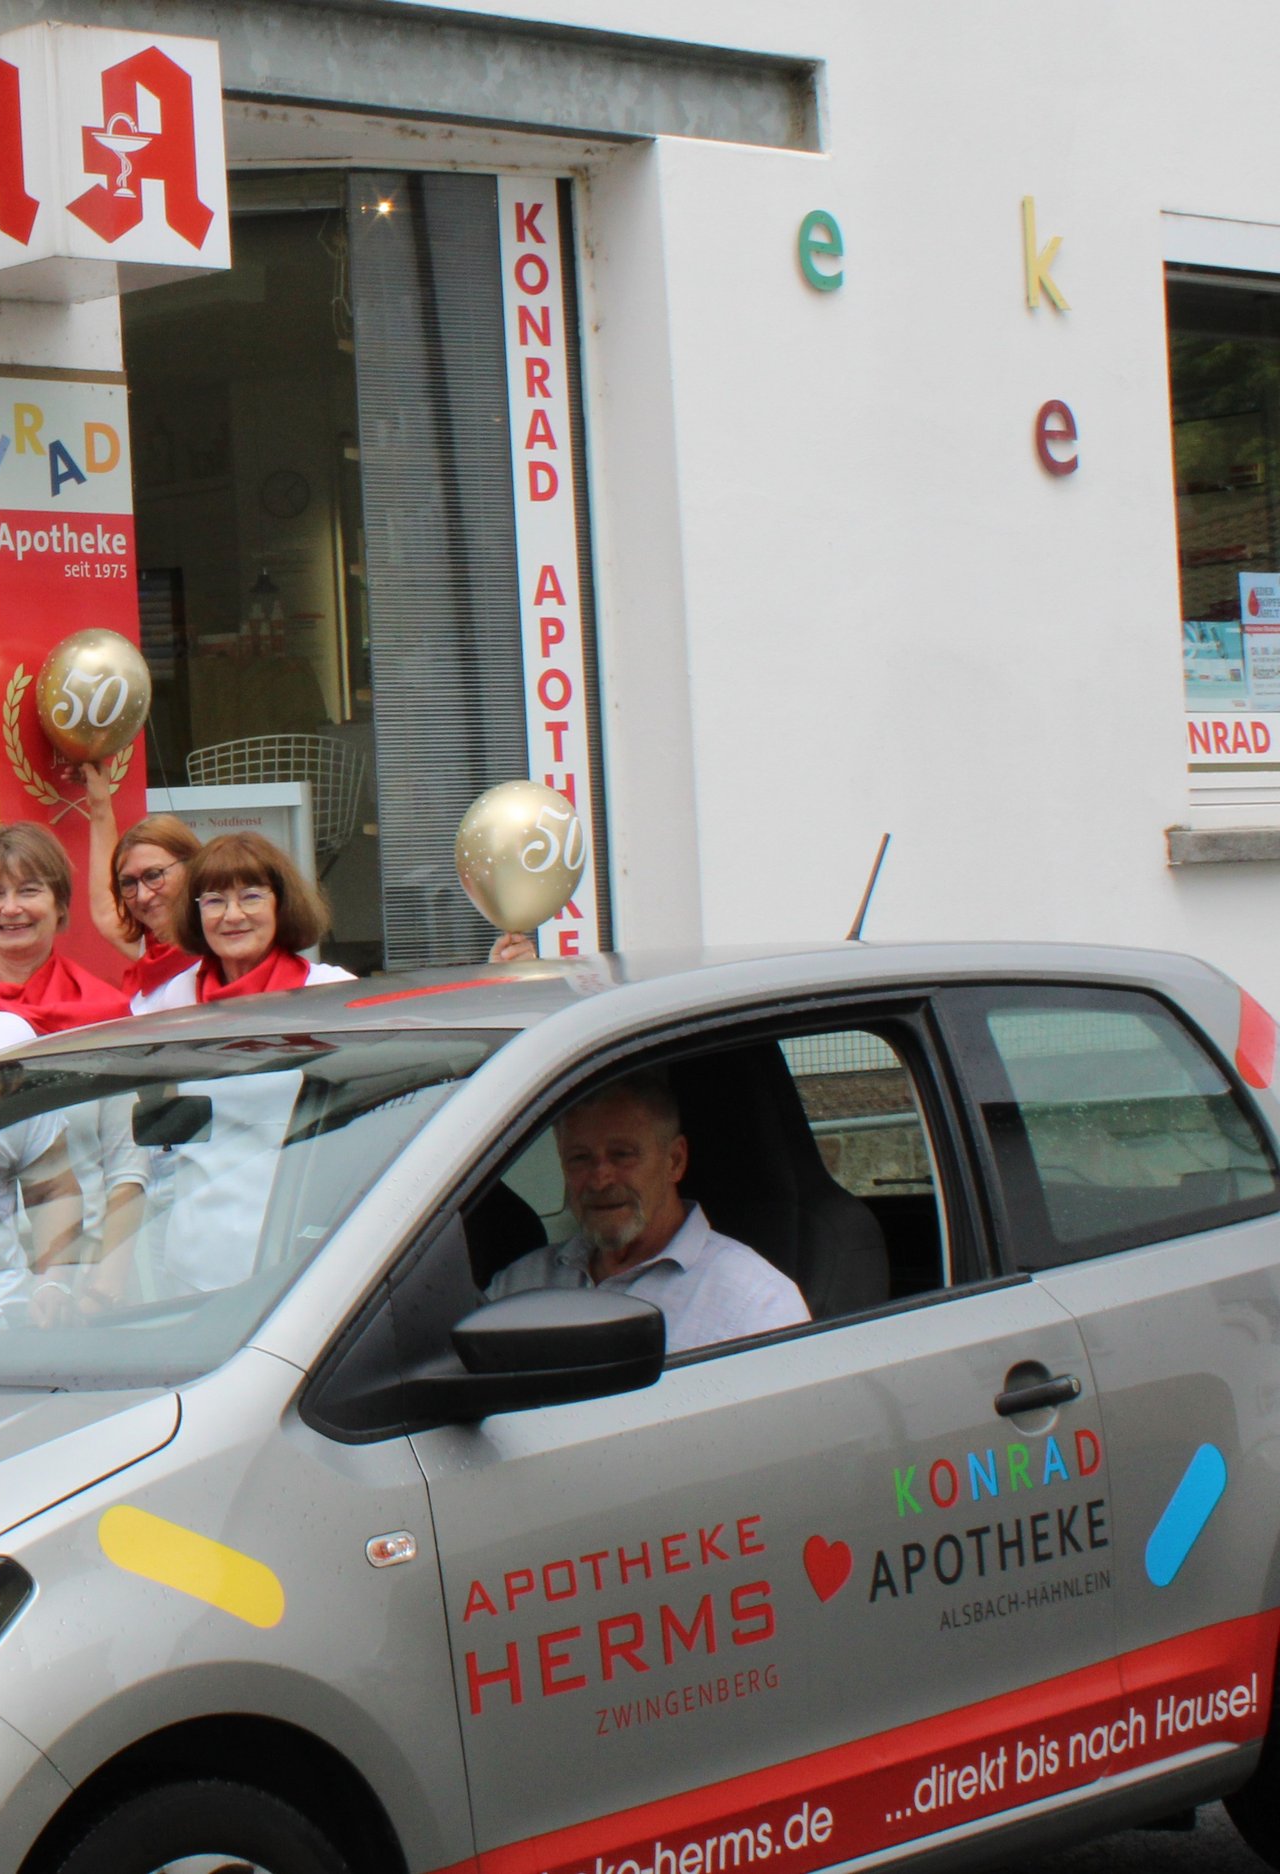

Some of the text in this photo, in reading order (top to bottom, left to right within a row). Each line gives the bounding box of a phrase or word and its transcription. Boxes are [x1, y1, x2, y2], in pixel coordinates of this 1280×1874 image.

[513, 202, 558, 502] KONRAD
[64, 561, 127, 579] seit 1975
[51, 668, 129, 730] 50
[1184, 720, 1271, 755] NRAD
[208, 816, 262, 828] Notdienst
[520, 805, 586, 874] 50
[892, 1428, 1103, 1518] KONRAD
[463, 1514, 768, 1623] APOTHEKE
[868, 1498, 1110, 1604] APOTHEKE
[939, 1570, 1112, 1631] ALSBACH-HÄHNLEIN
[465, 1580, 777, 1716] HERMS
[595, 1664, 780, 1735] ZWINGENBERG
[885, 1752, 1007, 1822] ...direkt
[1015, 1734, 1060, 1784] bis
[1068, 1707, 1146, 1768] nach
[1155, 1673, 1258, 1739] Hause!
